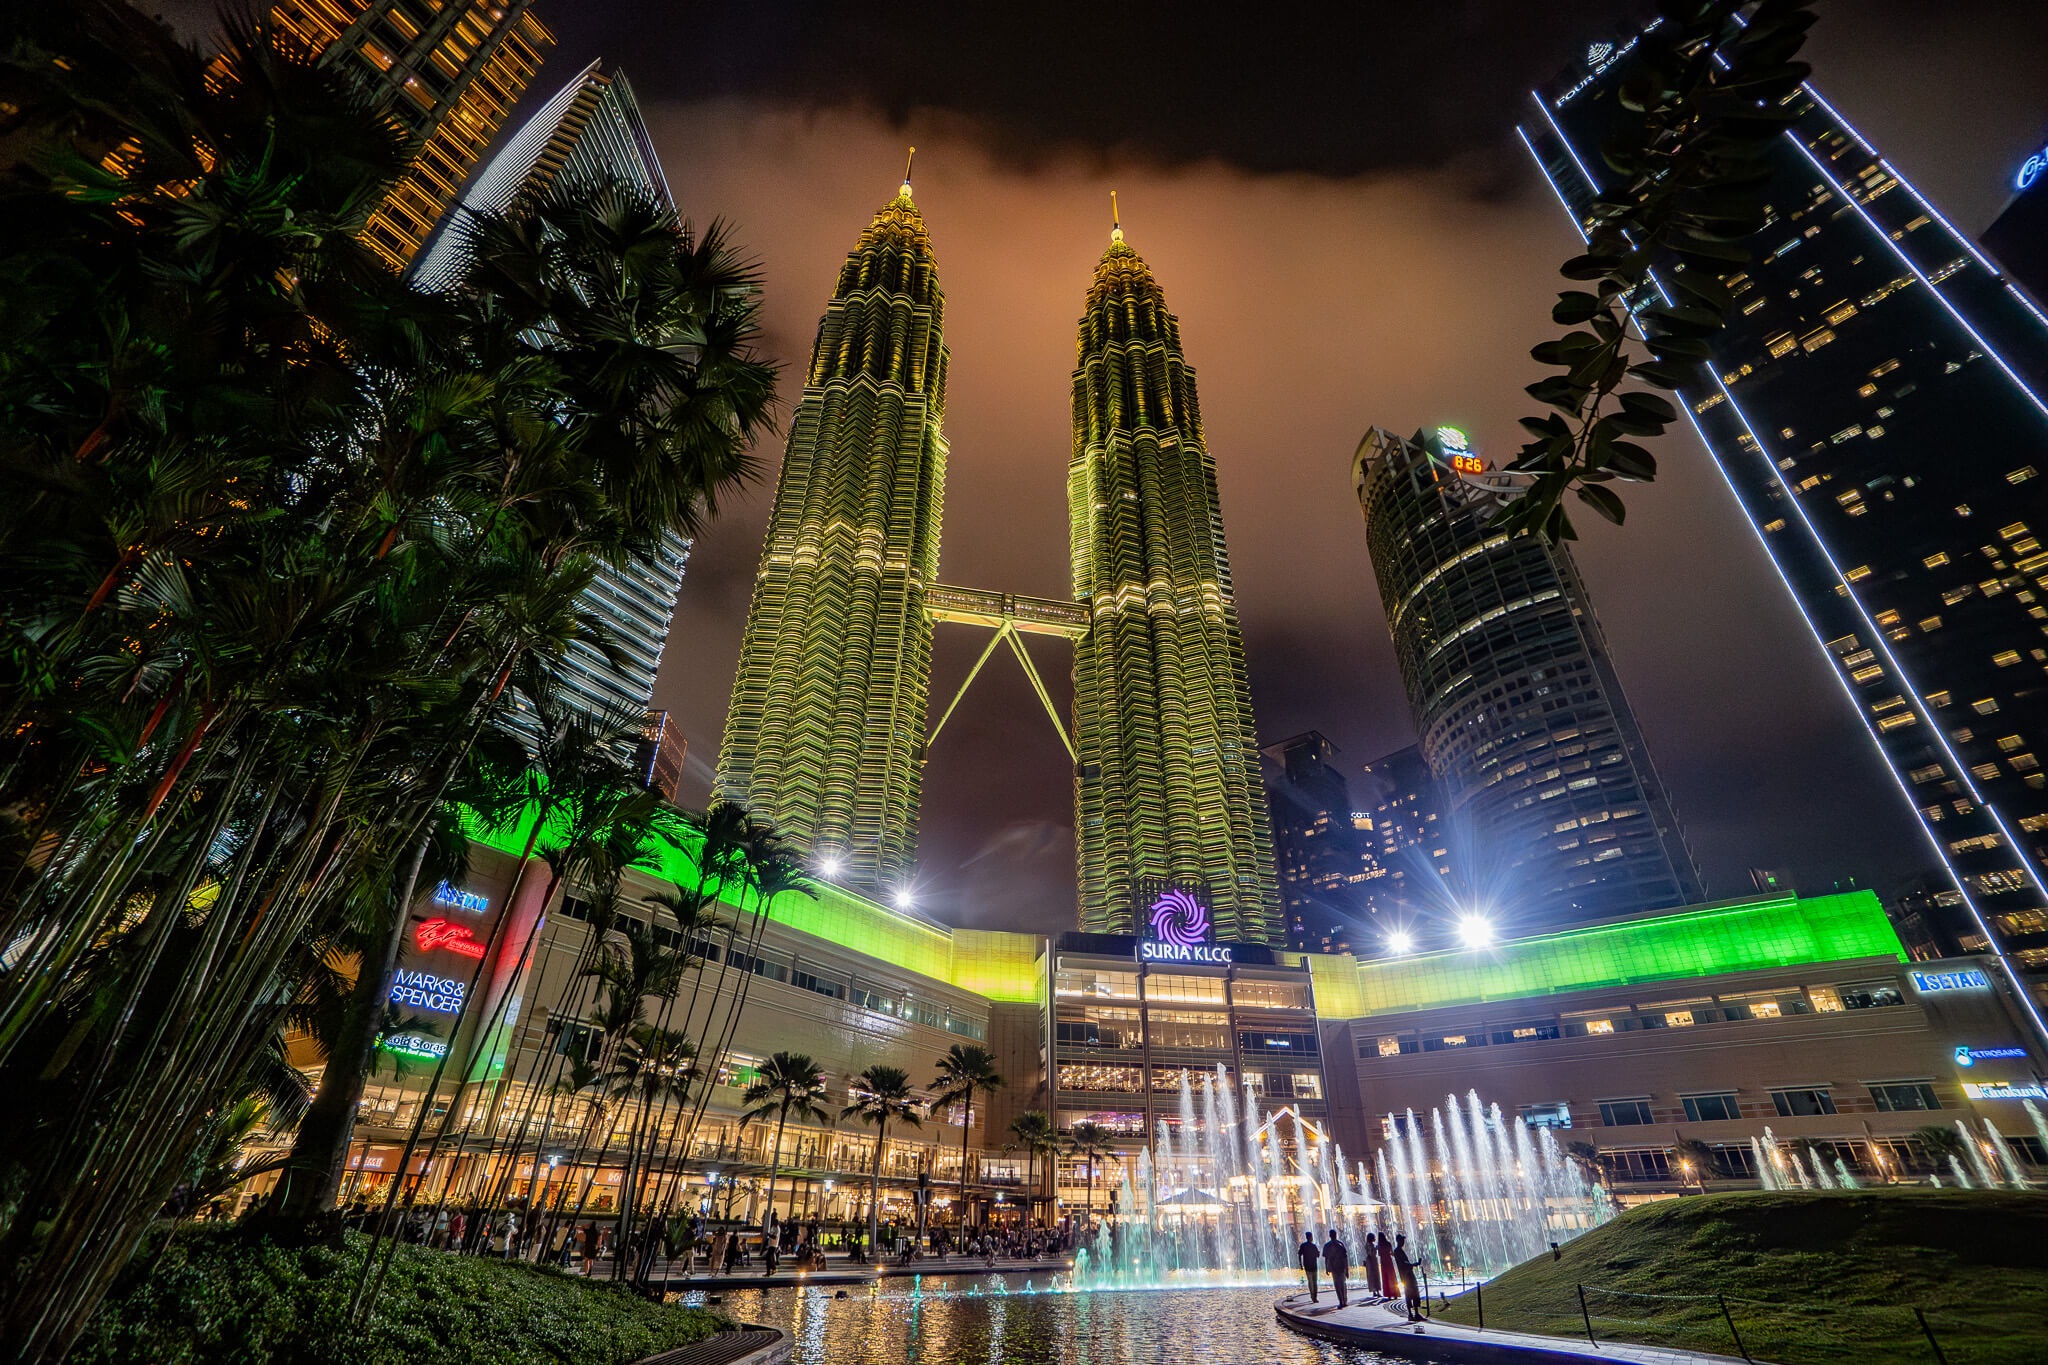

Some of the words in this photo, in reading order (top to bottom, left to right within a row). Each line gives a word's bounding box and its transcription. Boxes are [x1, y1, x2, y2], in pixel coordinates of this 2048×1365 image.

[1556, 74, 1595, 108] FOUR
[1143, 942, 1191, 960] SURIA
[1194, 946, 1232, 963] KLCC
[394, 968, 455, 995] MARKS
[390, 985, 462, 1014] SPENCER
[411, 1037, 447, 1055] Storag
[1979, 1085, 2048, 1100] Kinokuniy
